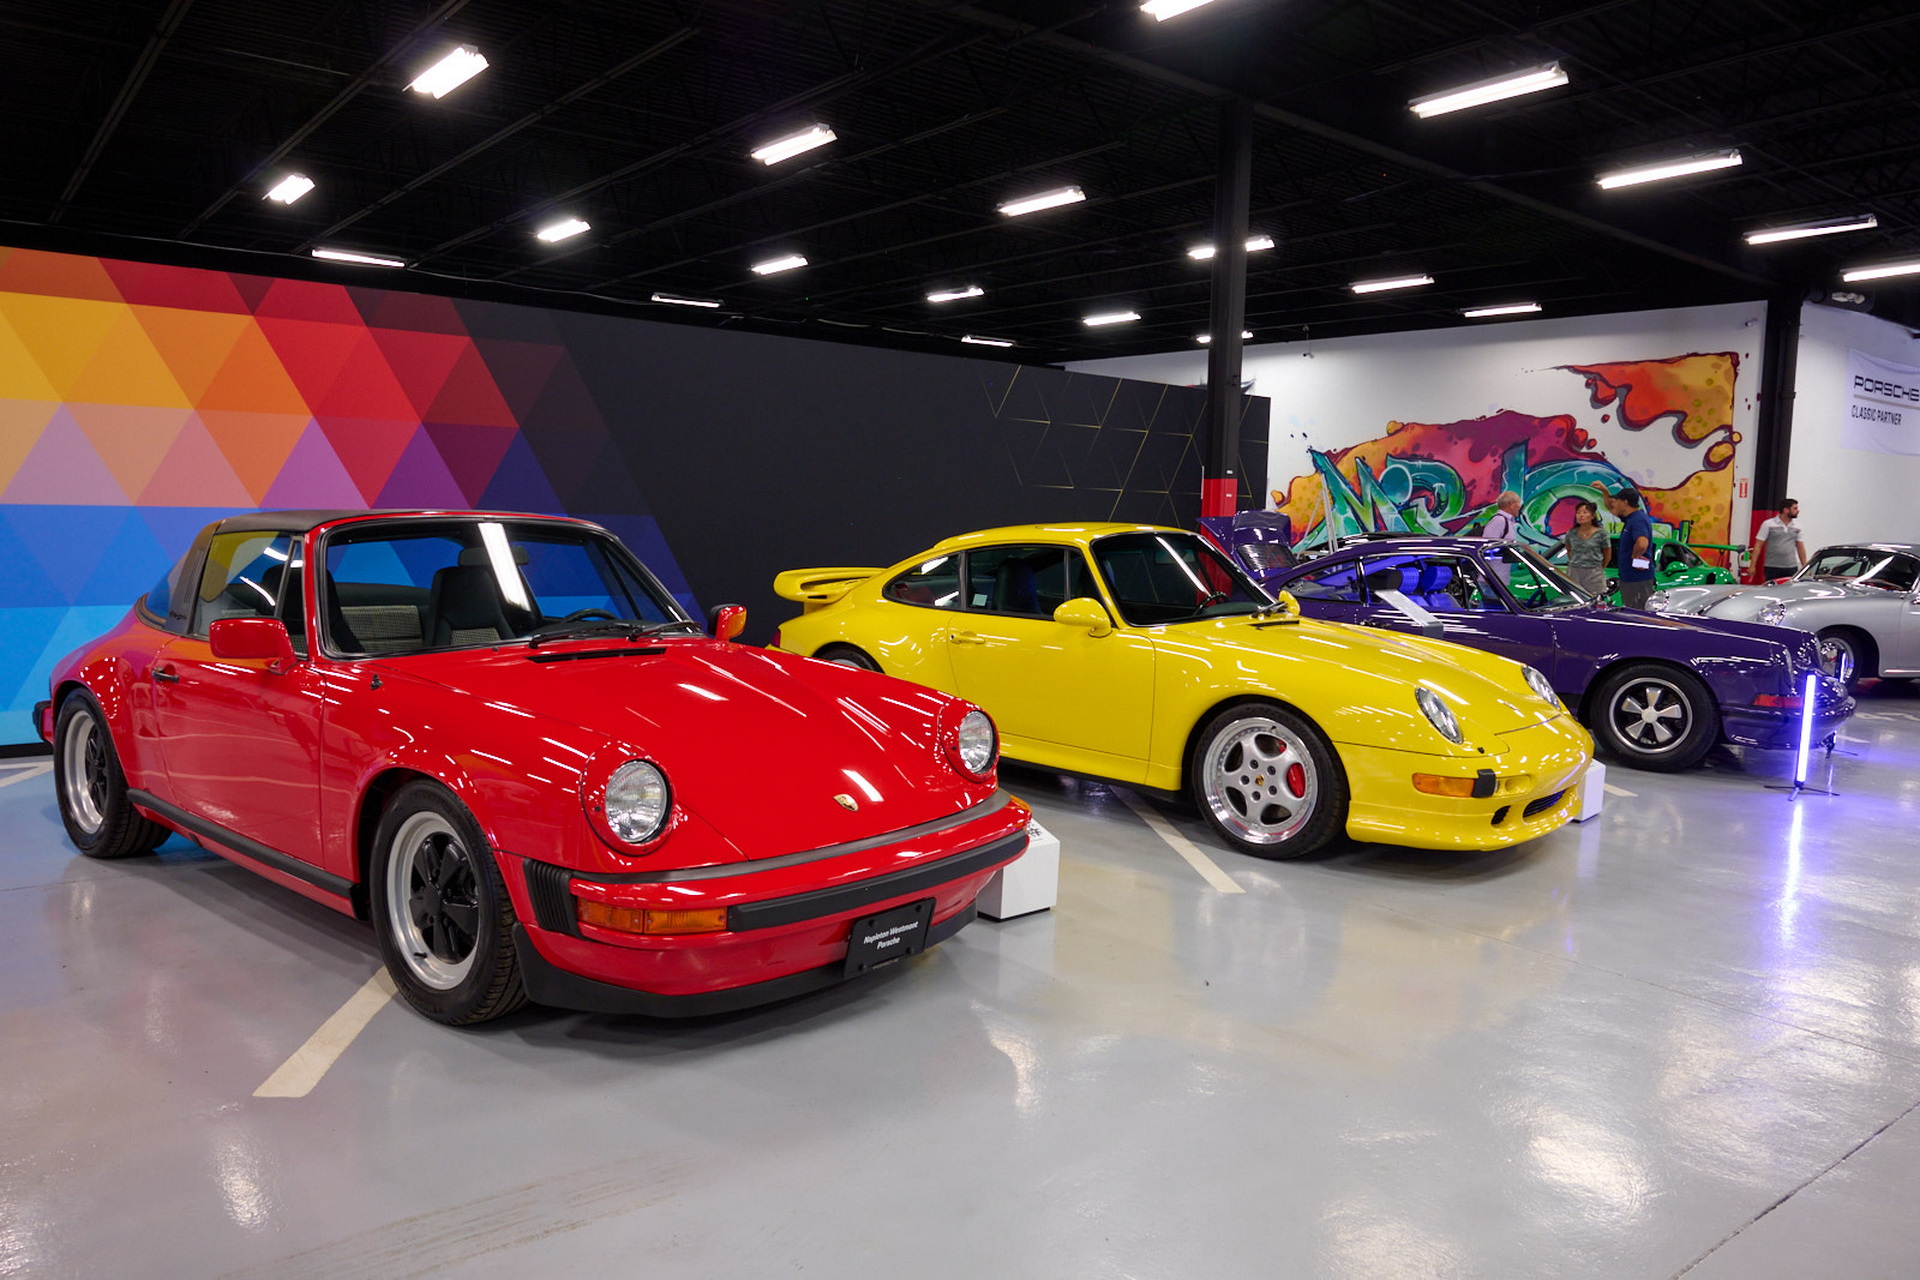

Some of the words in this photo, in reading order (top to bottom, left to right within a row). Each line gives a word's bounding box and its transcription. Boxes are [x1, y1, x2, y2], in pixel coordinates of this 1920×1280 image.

[1854, 375, 1920, 402] PORSCHE
[1852, 405, 1876, 421] CLASSIC
[1877, 410, 1902, 425] PARTNER
[889, 921, 919, 935] Westmont
[877, 936, 901, 949] Porsche
